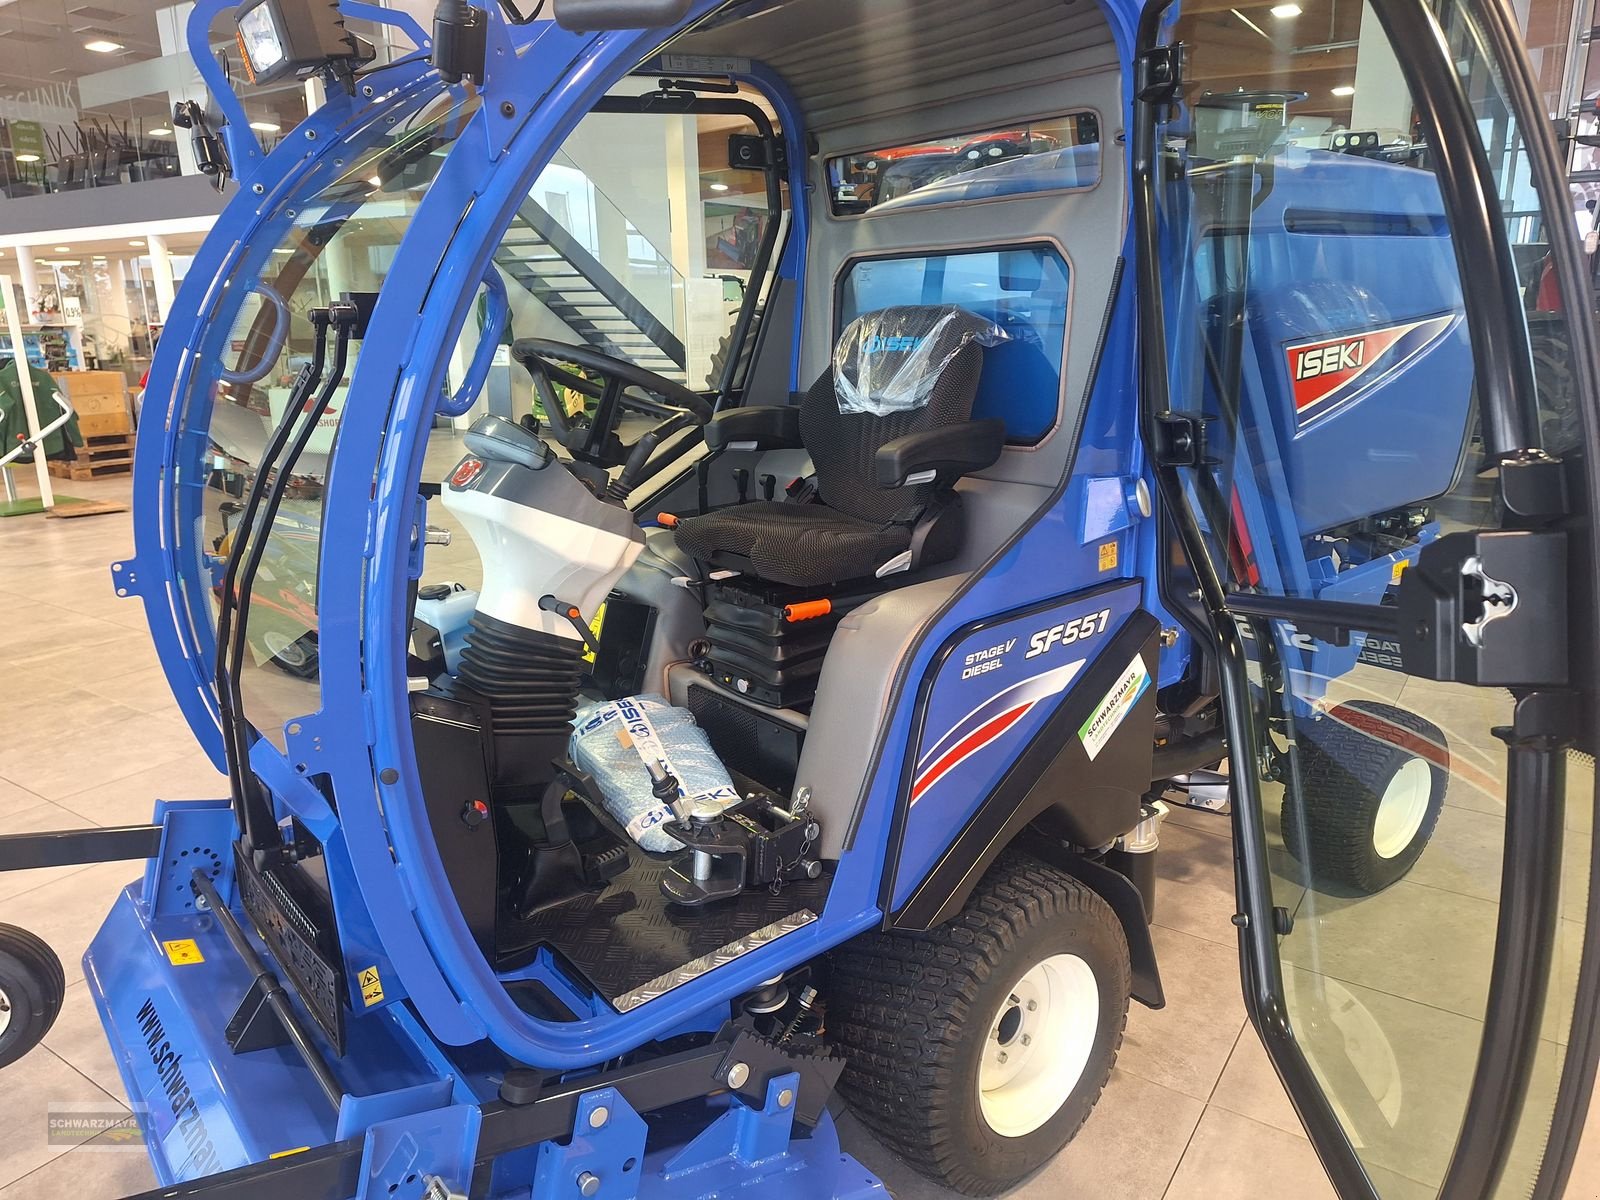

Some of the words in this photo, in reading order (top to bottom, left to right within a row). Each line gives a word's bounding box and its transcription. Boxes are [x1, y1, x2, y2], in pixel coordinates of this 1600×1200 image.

[1296, 339, 1364, 381] ISEKI
[965, 644, 1004, 666] STAGE
[1025, 608, 1111, 660] SF551
[961, 658, 1003, 680] DIESEL
[1087, 672, 1136, 737] SCHWARZMAYR
